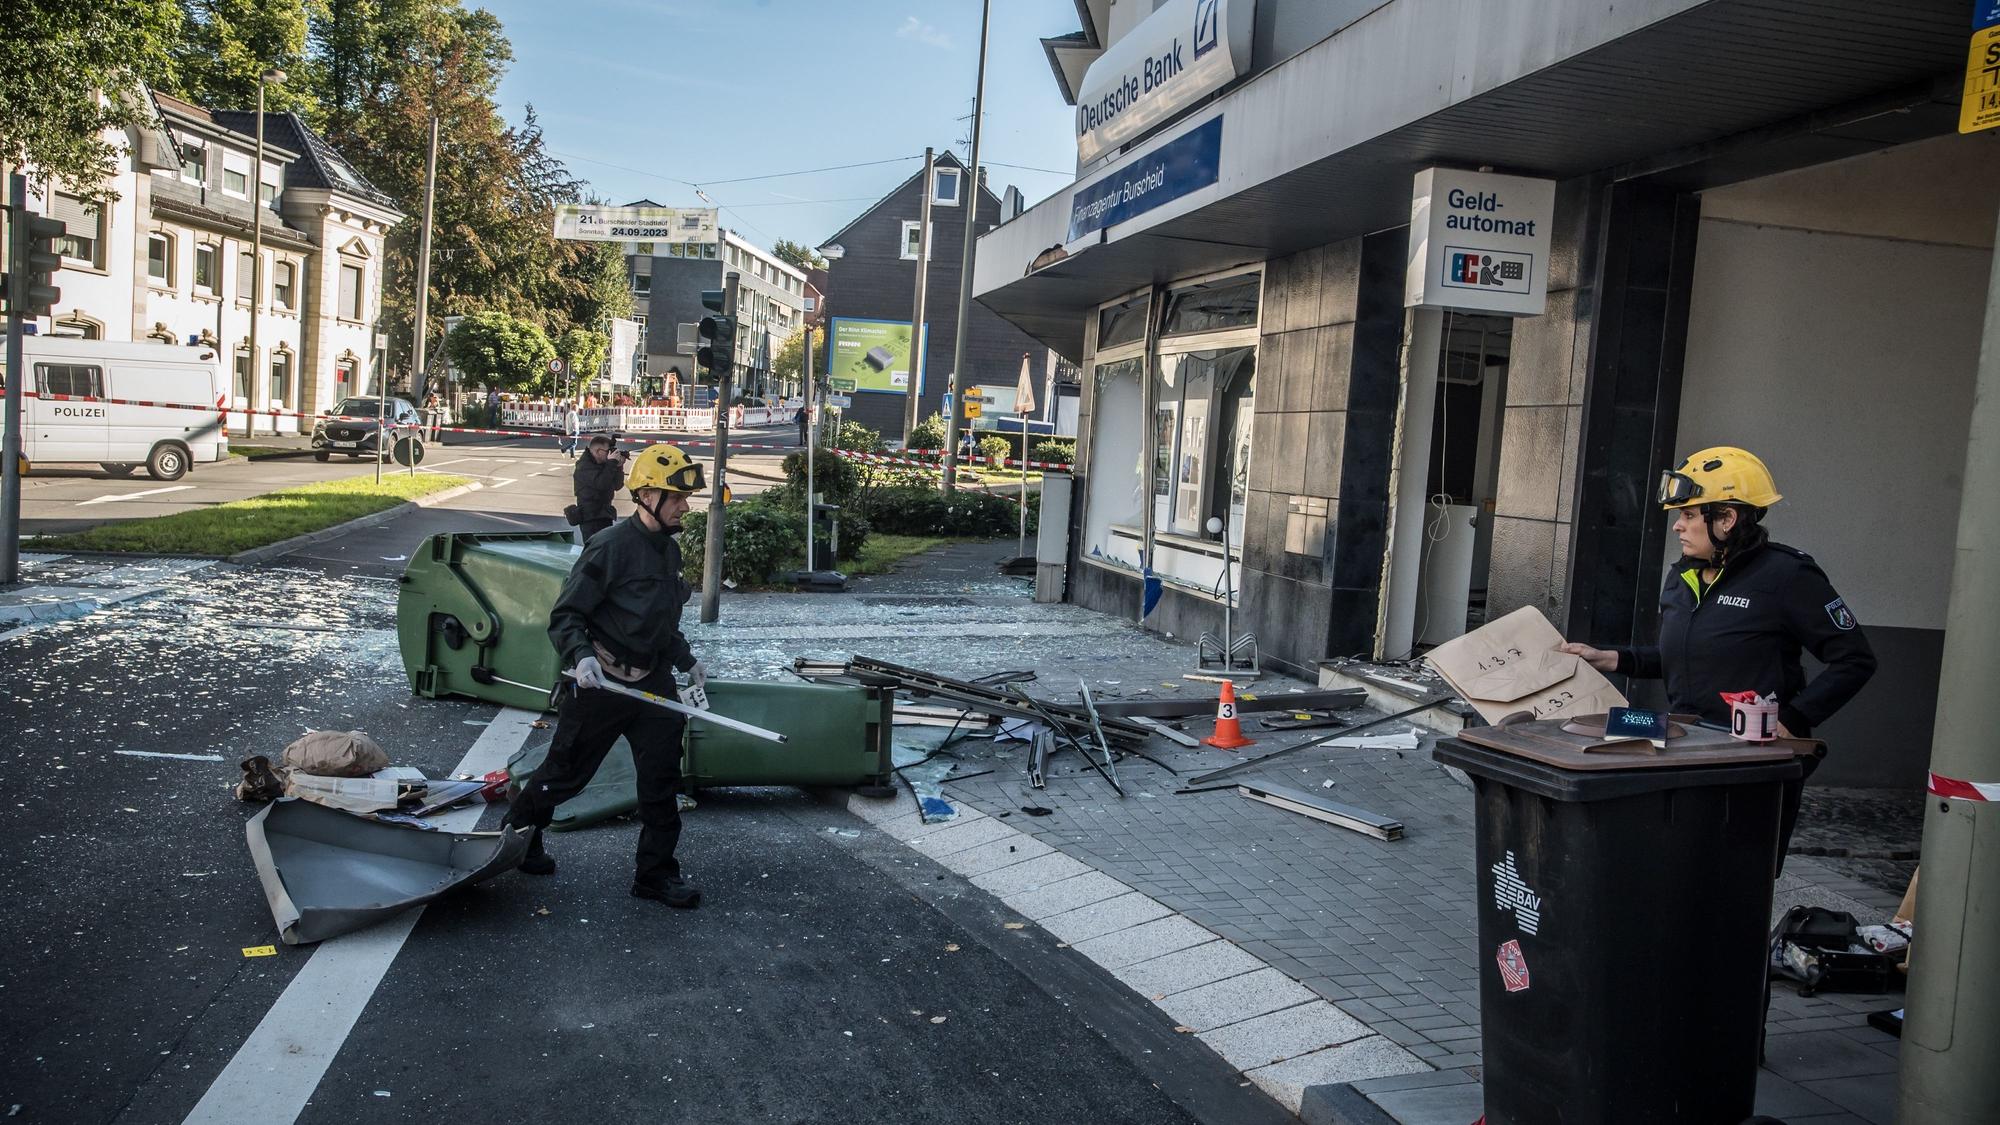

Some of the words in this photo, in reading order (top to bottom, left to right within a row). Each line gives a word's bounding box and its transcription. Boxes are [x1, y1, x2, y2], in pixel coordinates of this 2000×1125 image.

[1080, 75, 1139, 136] Deutsche
[1144, 38, 1184, 94] Bank
[1073, 189, 1122, 223] Finanzagentur
[1122, 162, 1165, 203] Burscheid
[1448, 189, 1504, 212] Geld-
[580, 214, 597, 224] 21.
[1446, 214, 1536, 237] automat
[611, 227, 668, 237] 24.09.2023
[54, 407, 105, 418] POLIZEI
[1717, 594, 1750, 609] POLIZEI
[1222, 703, 1233, 718] 3
[1517, 889, 1541, 911] BAV
